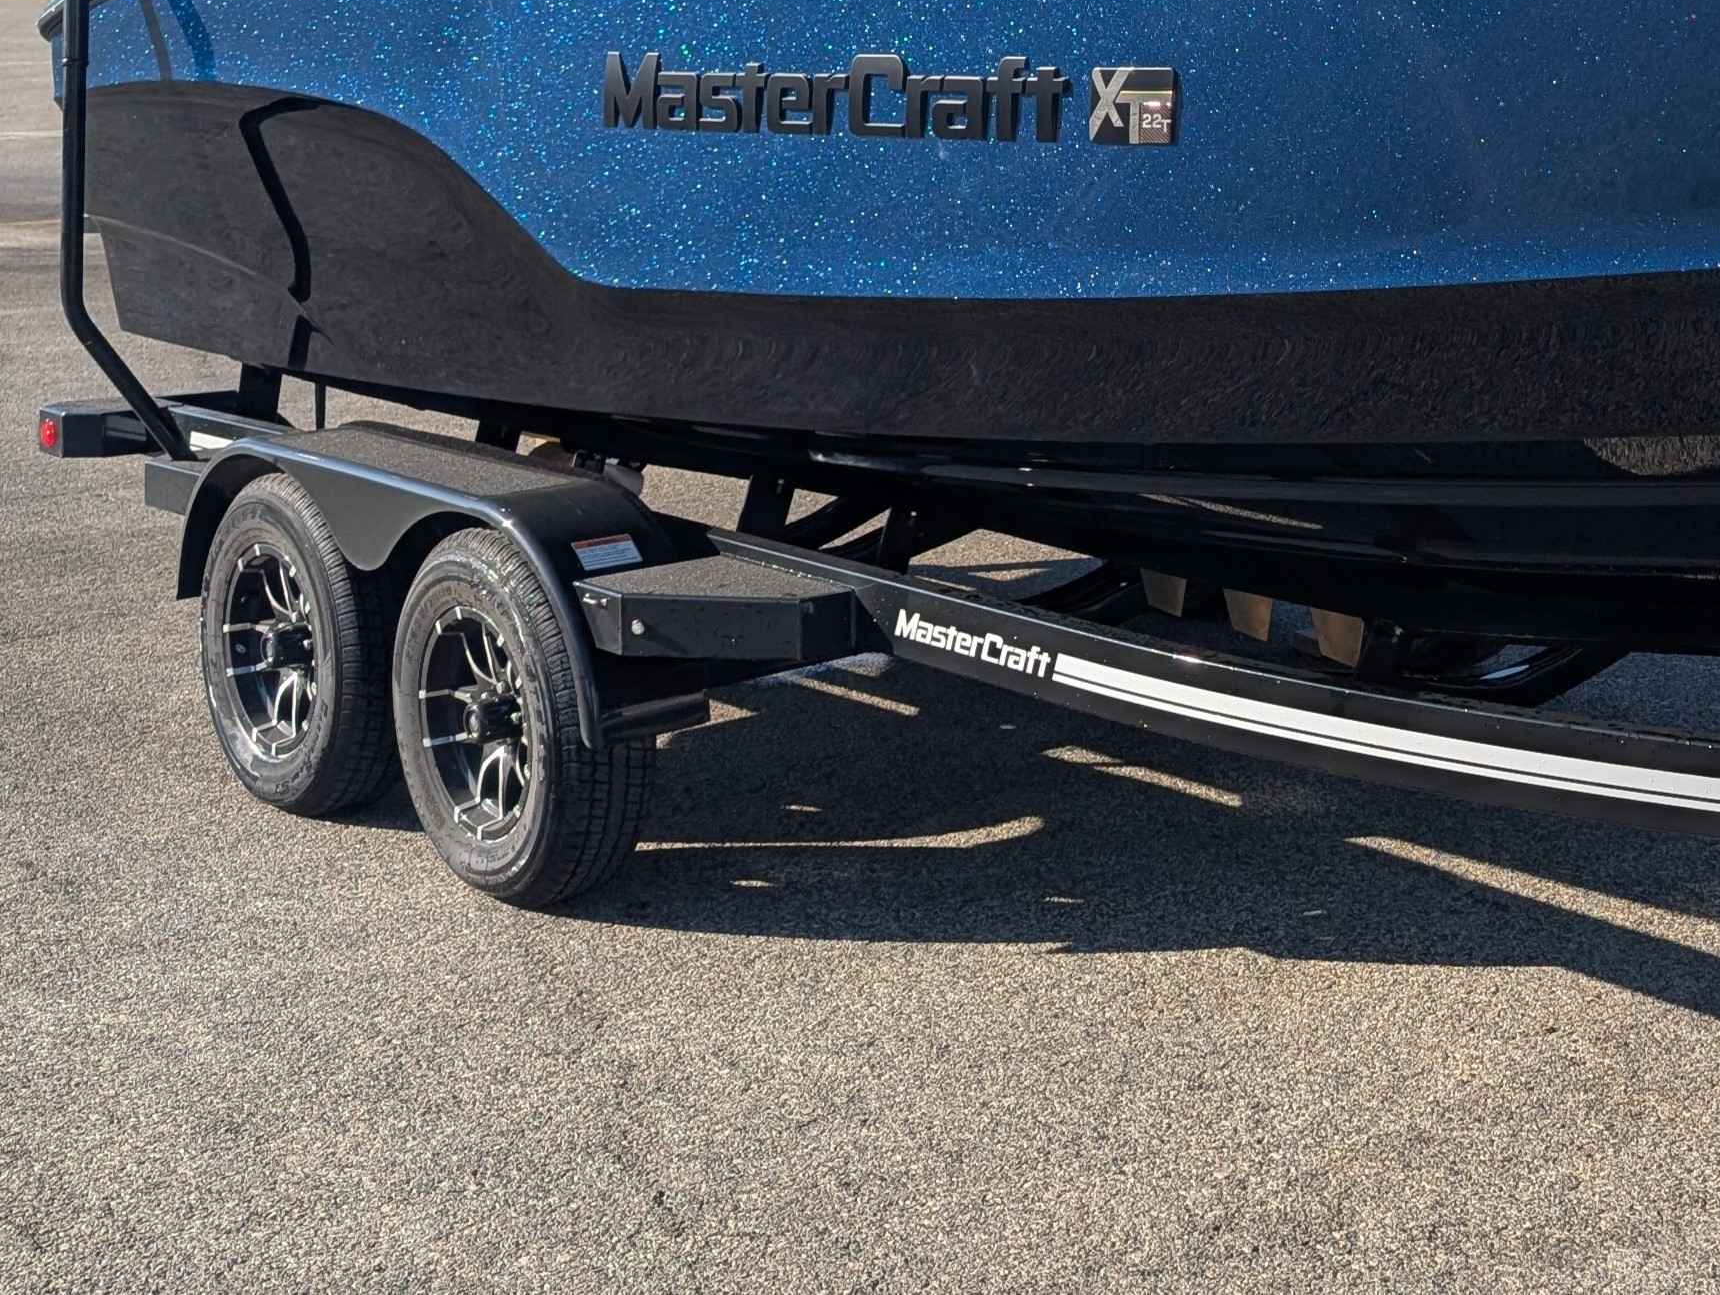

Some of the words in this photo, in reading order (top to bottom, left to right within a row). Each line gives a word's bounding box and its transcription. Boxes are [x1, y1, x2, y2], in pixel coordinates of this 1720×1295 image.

[603, 51, 1069, 143] MasterCraft
[1142, 113, 1172, 133] 22T
[894, 608, 1052, 678] MasterCraft
